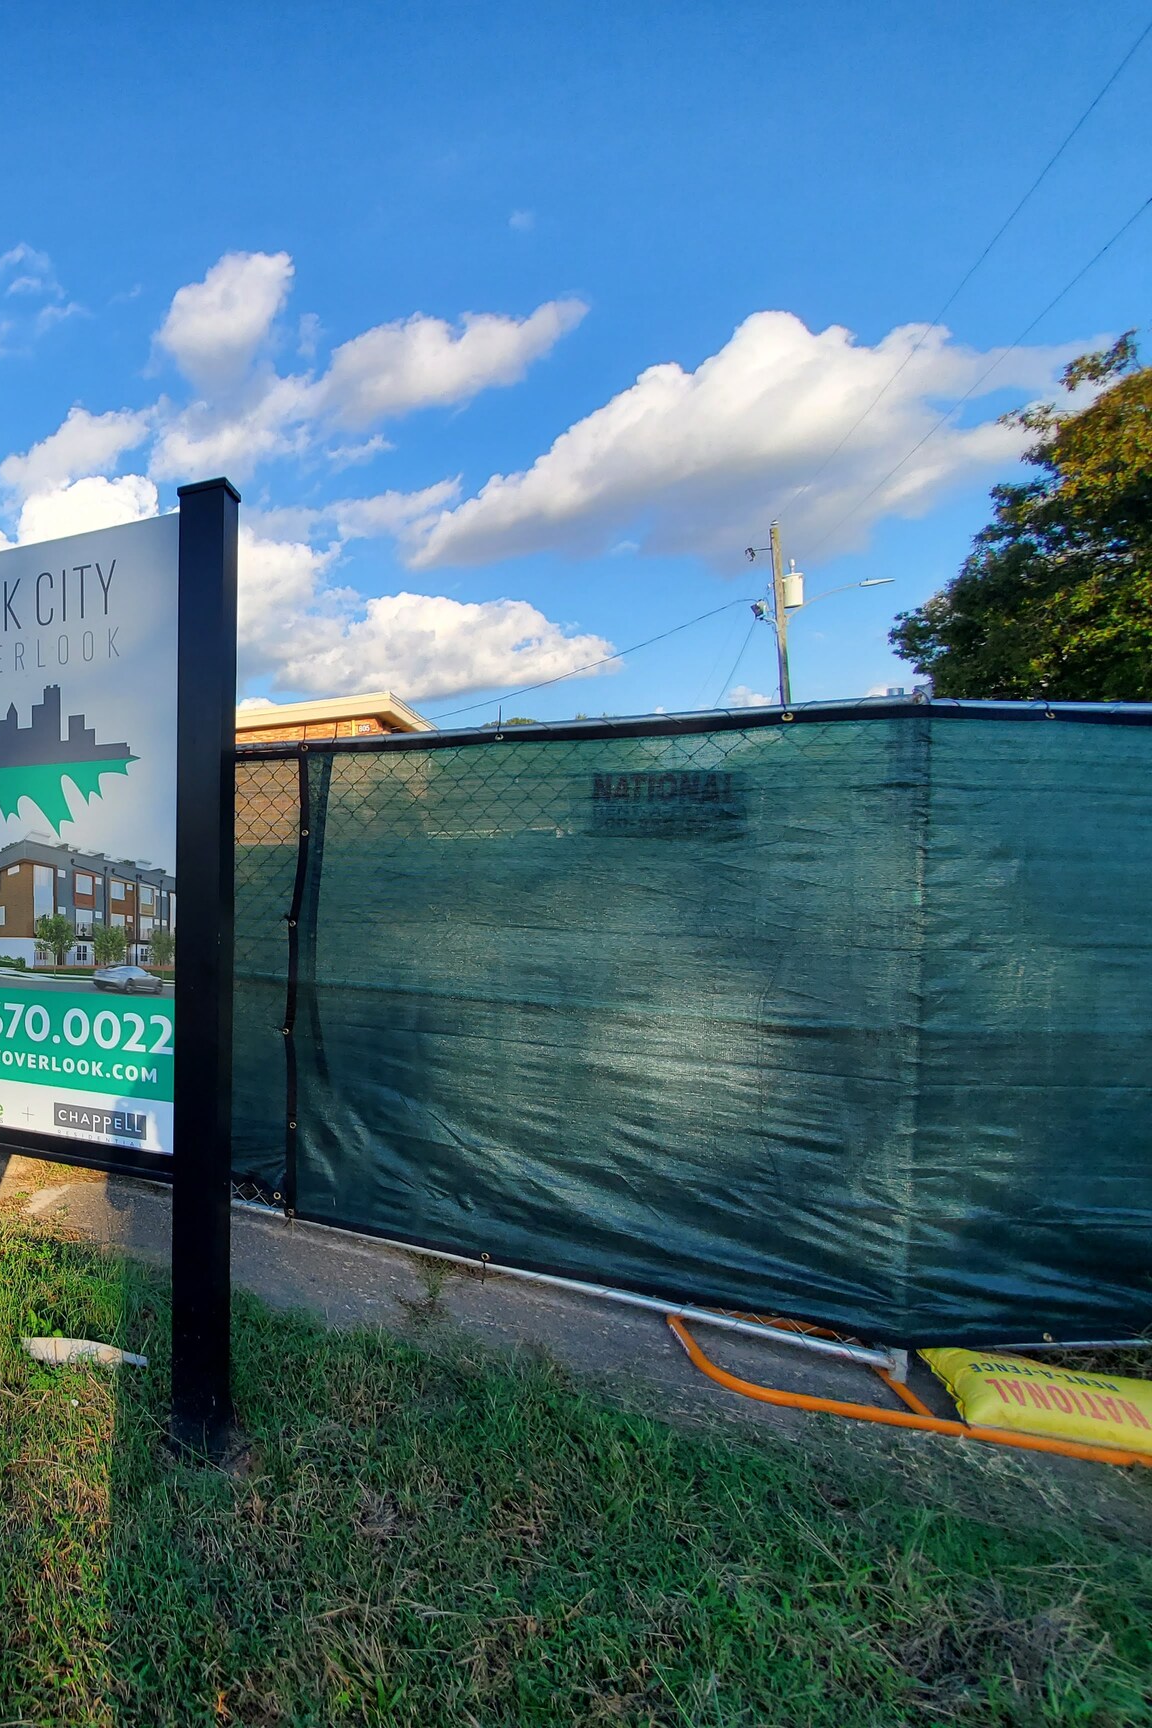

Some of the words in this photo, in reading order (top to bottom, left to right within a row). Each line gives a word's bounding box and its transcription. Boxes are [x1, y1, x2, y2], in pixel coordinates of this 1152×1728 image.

[35, 559, 117, 627] CITY
[593, 771, 744, 804] NATIONAL
[57, 1109, 142, 1135] CHAPPELL
[57, 1129, 142, 1148] RESIDENTIAL
[968, 1362, 1120, 1392] RENT-A-FENCE
[984, 1378, 1152, 1431] NATIONAL
